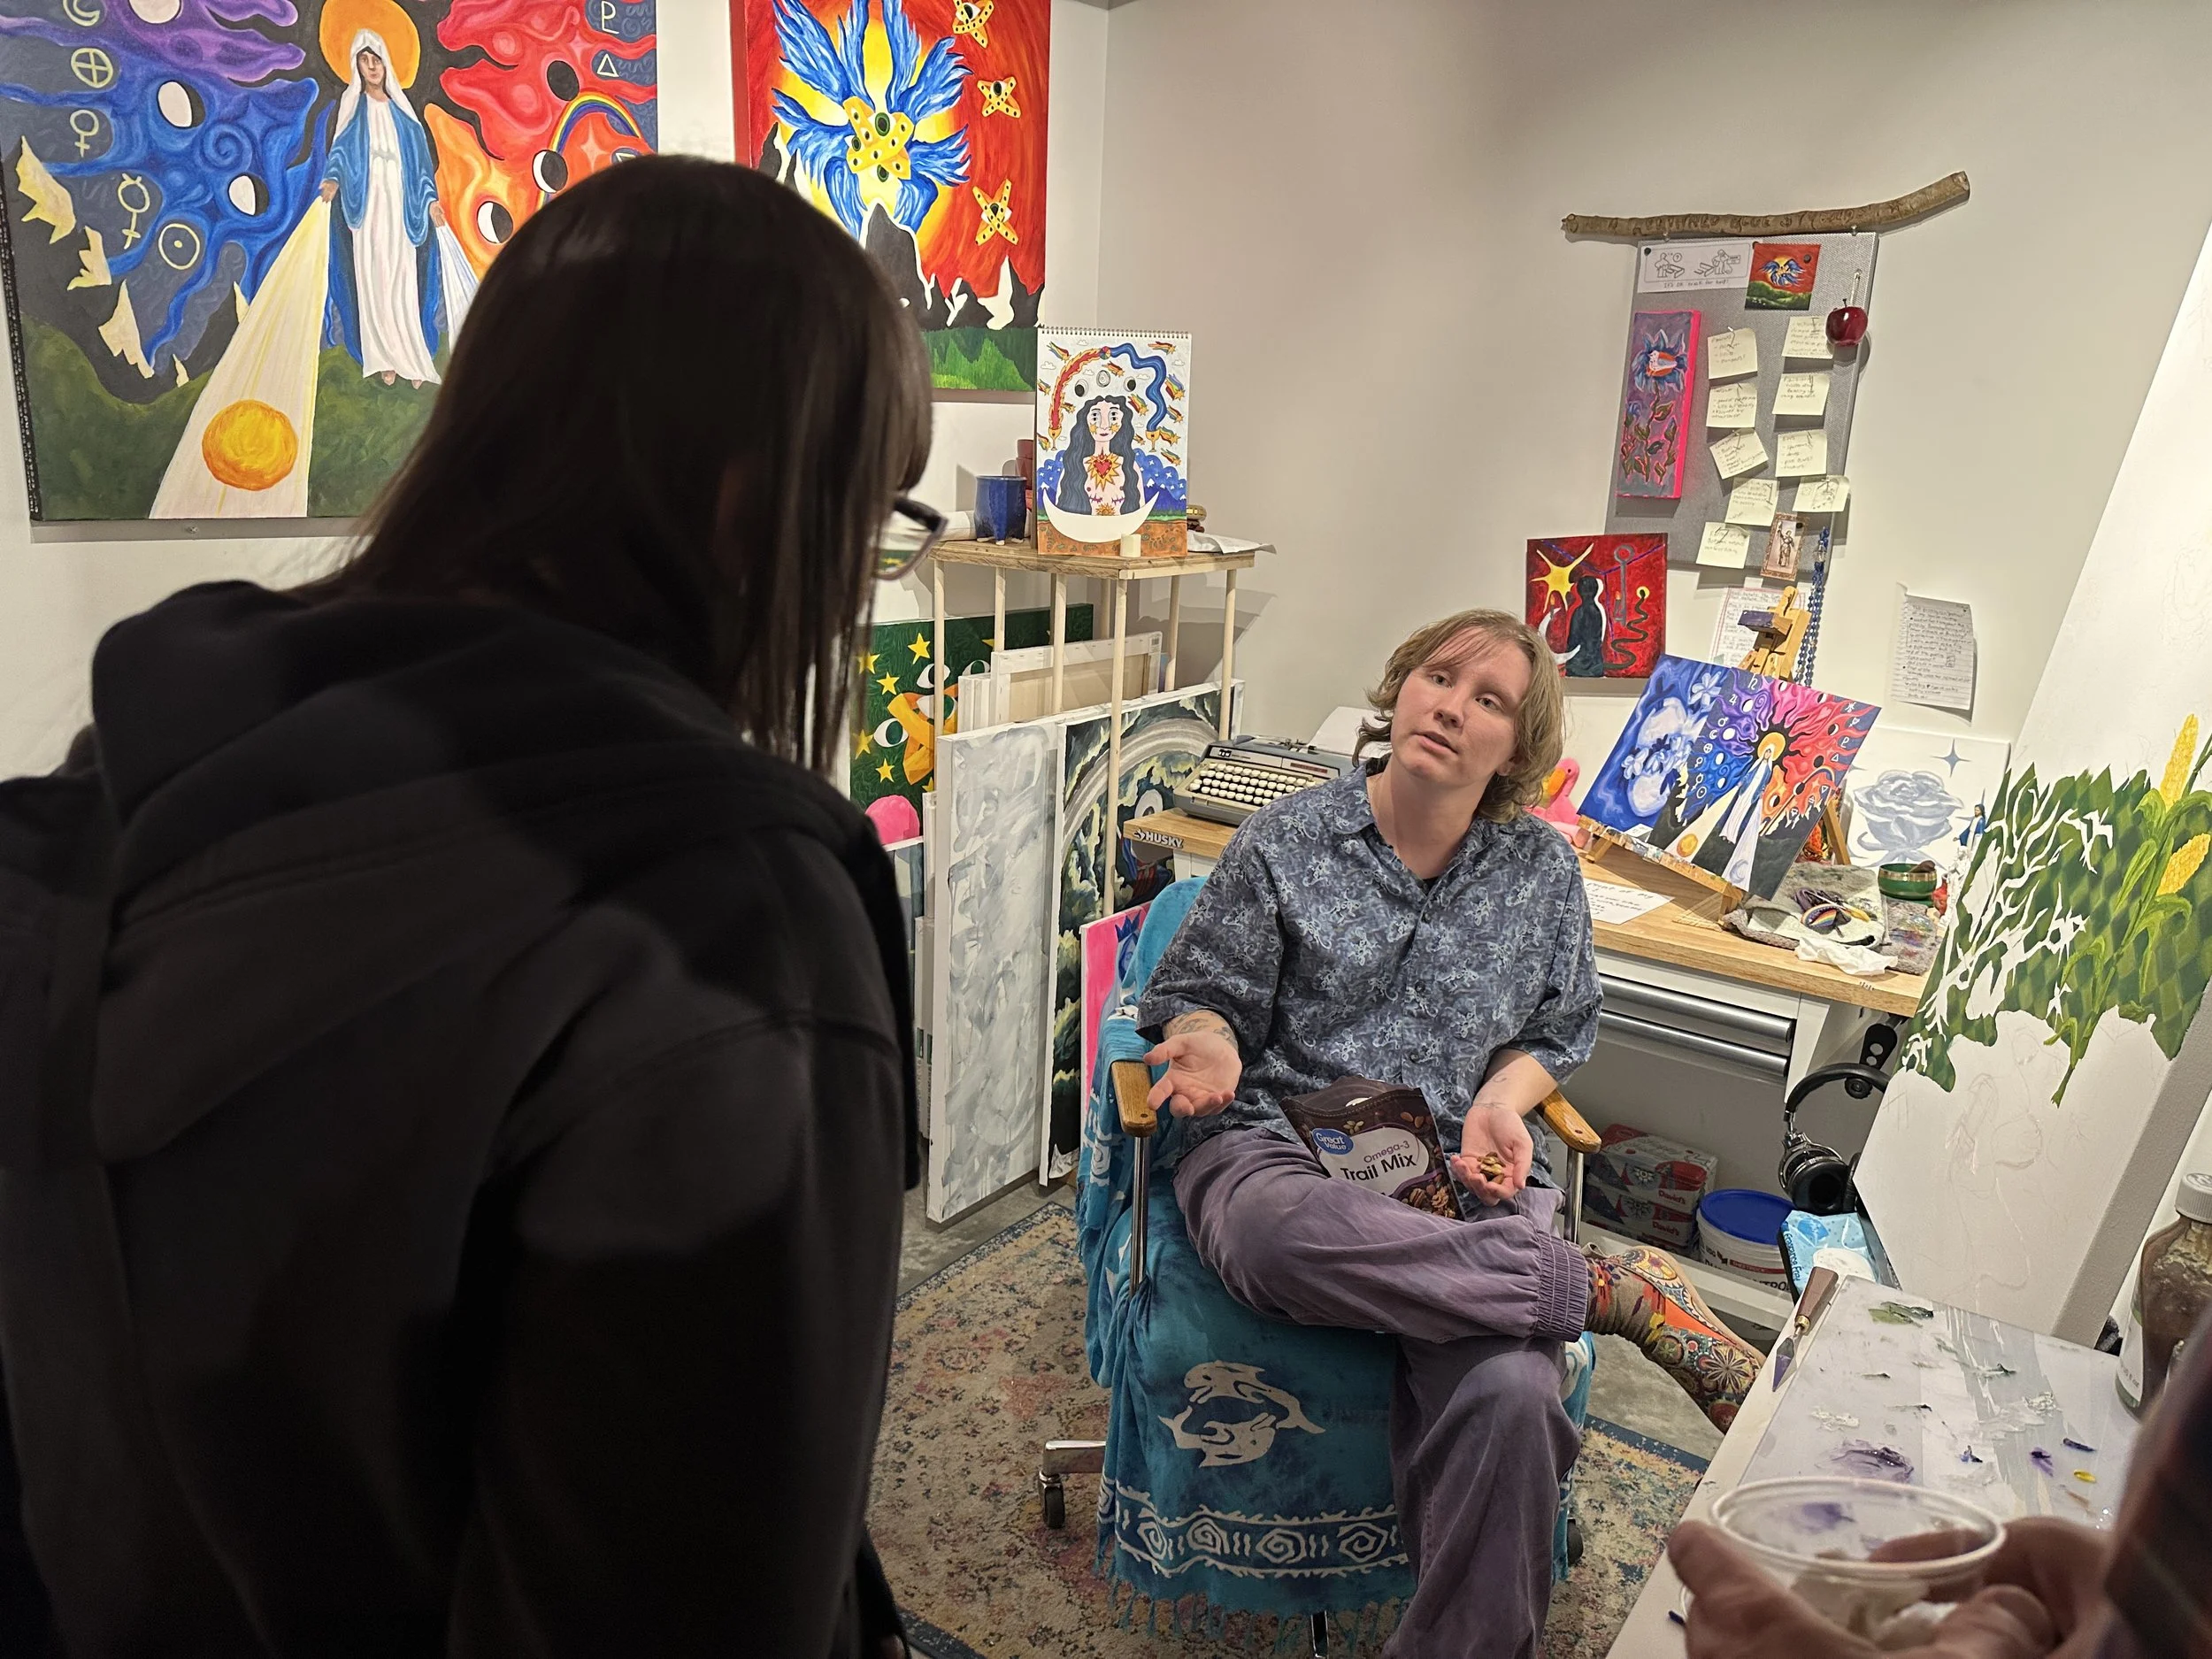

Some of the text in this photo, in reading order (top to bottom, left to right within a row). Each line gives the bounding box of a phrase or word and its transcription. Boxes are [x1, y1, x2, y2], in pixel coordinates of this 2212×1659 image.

[1146, 832, 1183, 848] HUSKY
[1316, 1133, 1345, 1144] Great
[1325, 1141, 1347, 1150] Value
[1363, 1141, 1409, 1164] Omega-3
[1340, 1154, 1417, 1181] Trail Mix
[1658, 1190, 1686, 1204] David's
[1653, 1221, 1679, 1236] David's
